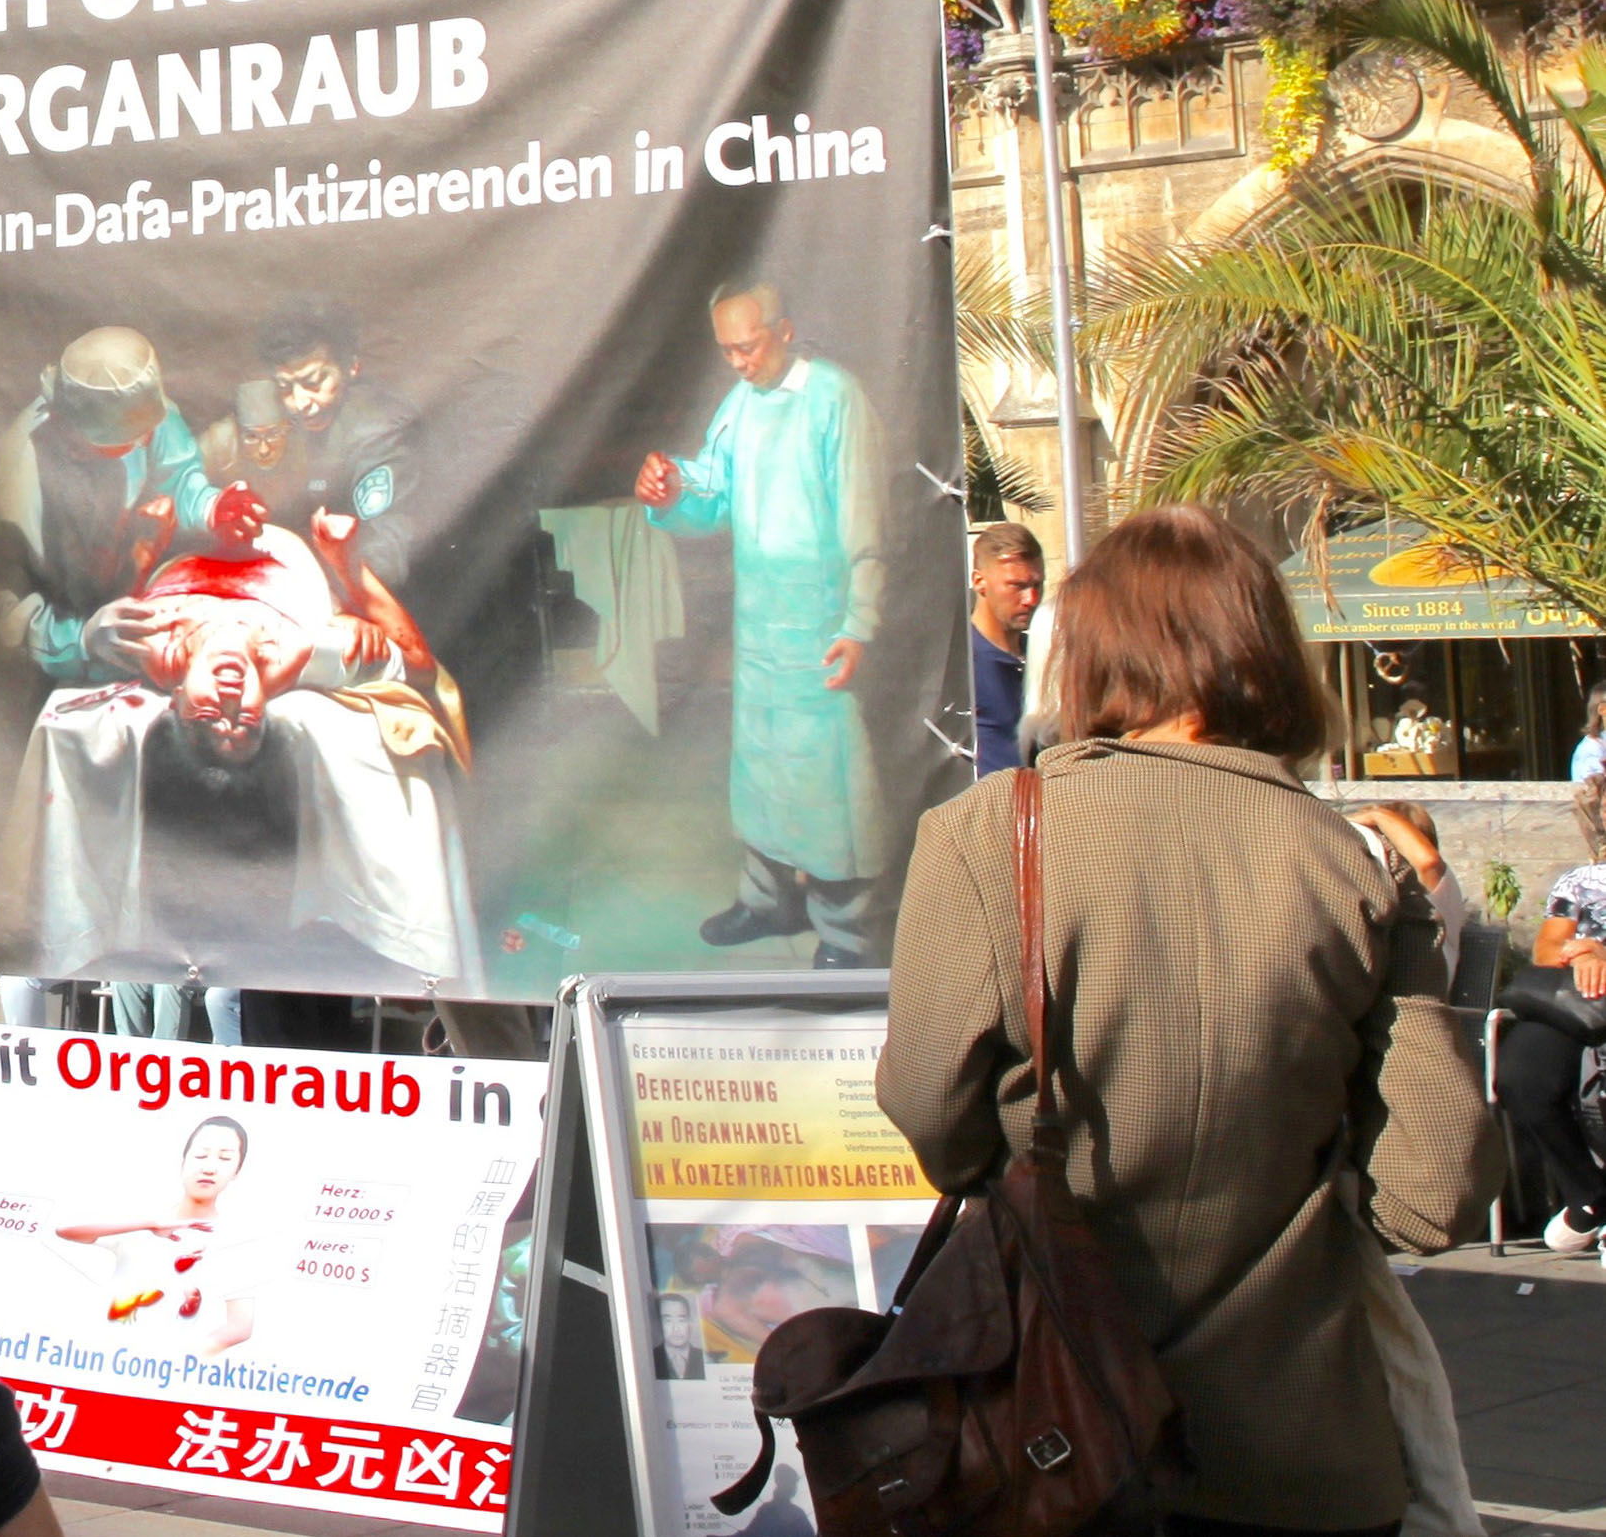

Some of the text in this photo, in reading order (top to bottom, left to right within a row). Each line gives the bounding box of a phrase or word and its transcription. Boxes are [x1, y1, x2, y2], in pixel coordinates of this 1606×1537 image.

[634, 131, 684, 193] in
[705, 114, 887, 187] China
[1362, 600, 1463, 618] Since 1884
[1351, 622, 1389, 633] amber
[1391, 621, 1442, 635] company
[1445, 620, 1458, 632] in
[1459, 620, 1478, 632] the
[56, 1037, 423, 1118] Organraub
[449, 1064, 512, 1128] in
[636, 1073, 778, 1103] BEREICHERUNG
[642, 1116, 804, 1145] AN ORGANHANDEL
[647, 1158, 916, 1188] IN KONZENTRATIONSLAGERN
[321, 1183, 366, 1199] Herz:
[304, 1239, 355, 1255] Niere:
[296, 1258, 318, 1275] 40
[322, 1262, 356, 1280] 000
[35, 1336, 104, 1374] Falun
[111, 1346, 370, 1404] Gong-Praktizierende
